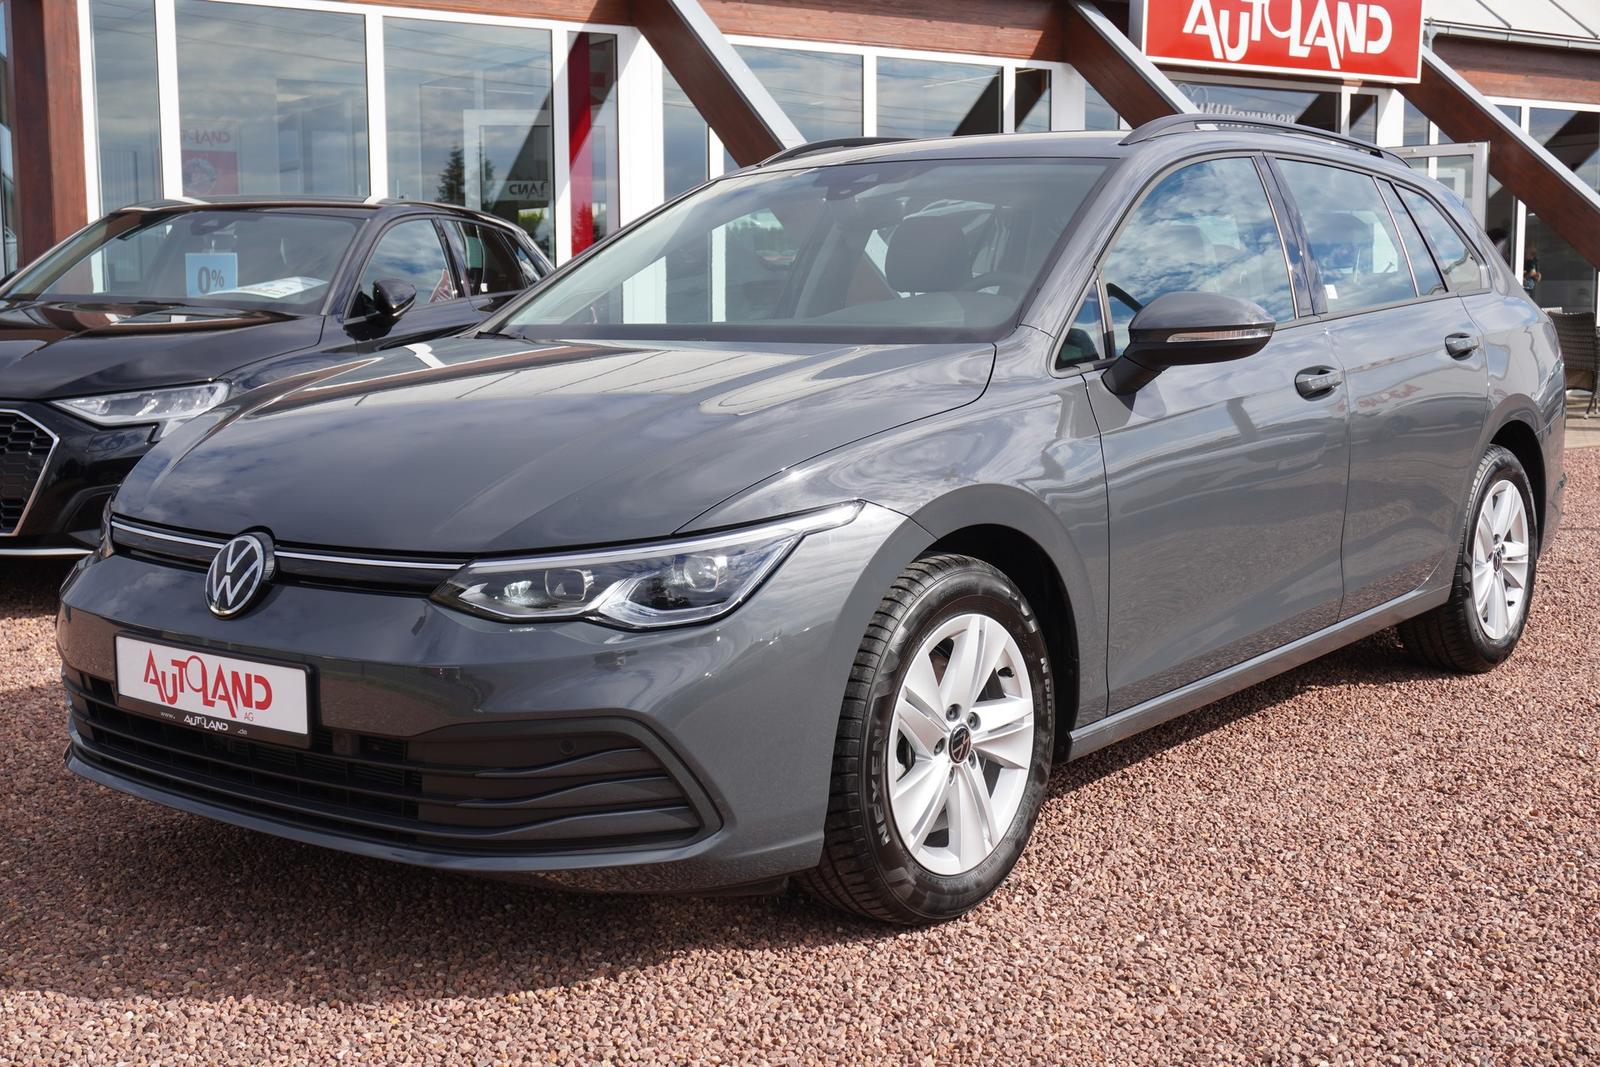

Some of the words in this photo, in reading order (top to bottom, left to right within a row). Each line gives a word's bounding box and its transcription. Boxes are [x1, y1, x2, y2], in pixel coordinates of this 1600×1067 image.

[1182, 0, 1393, 69] AUTOLAND
[197, 266, 225, 294] 0%
[143, 648, 273, 719] AUTOLAND
[183, 714, 229, 731] AUTOLAND
[871, 734, 891, 846] NEXEN
